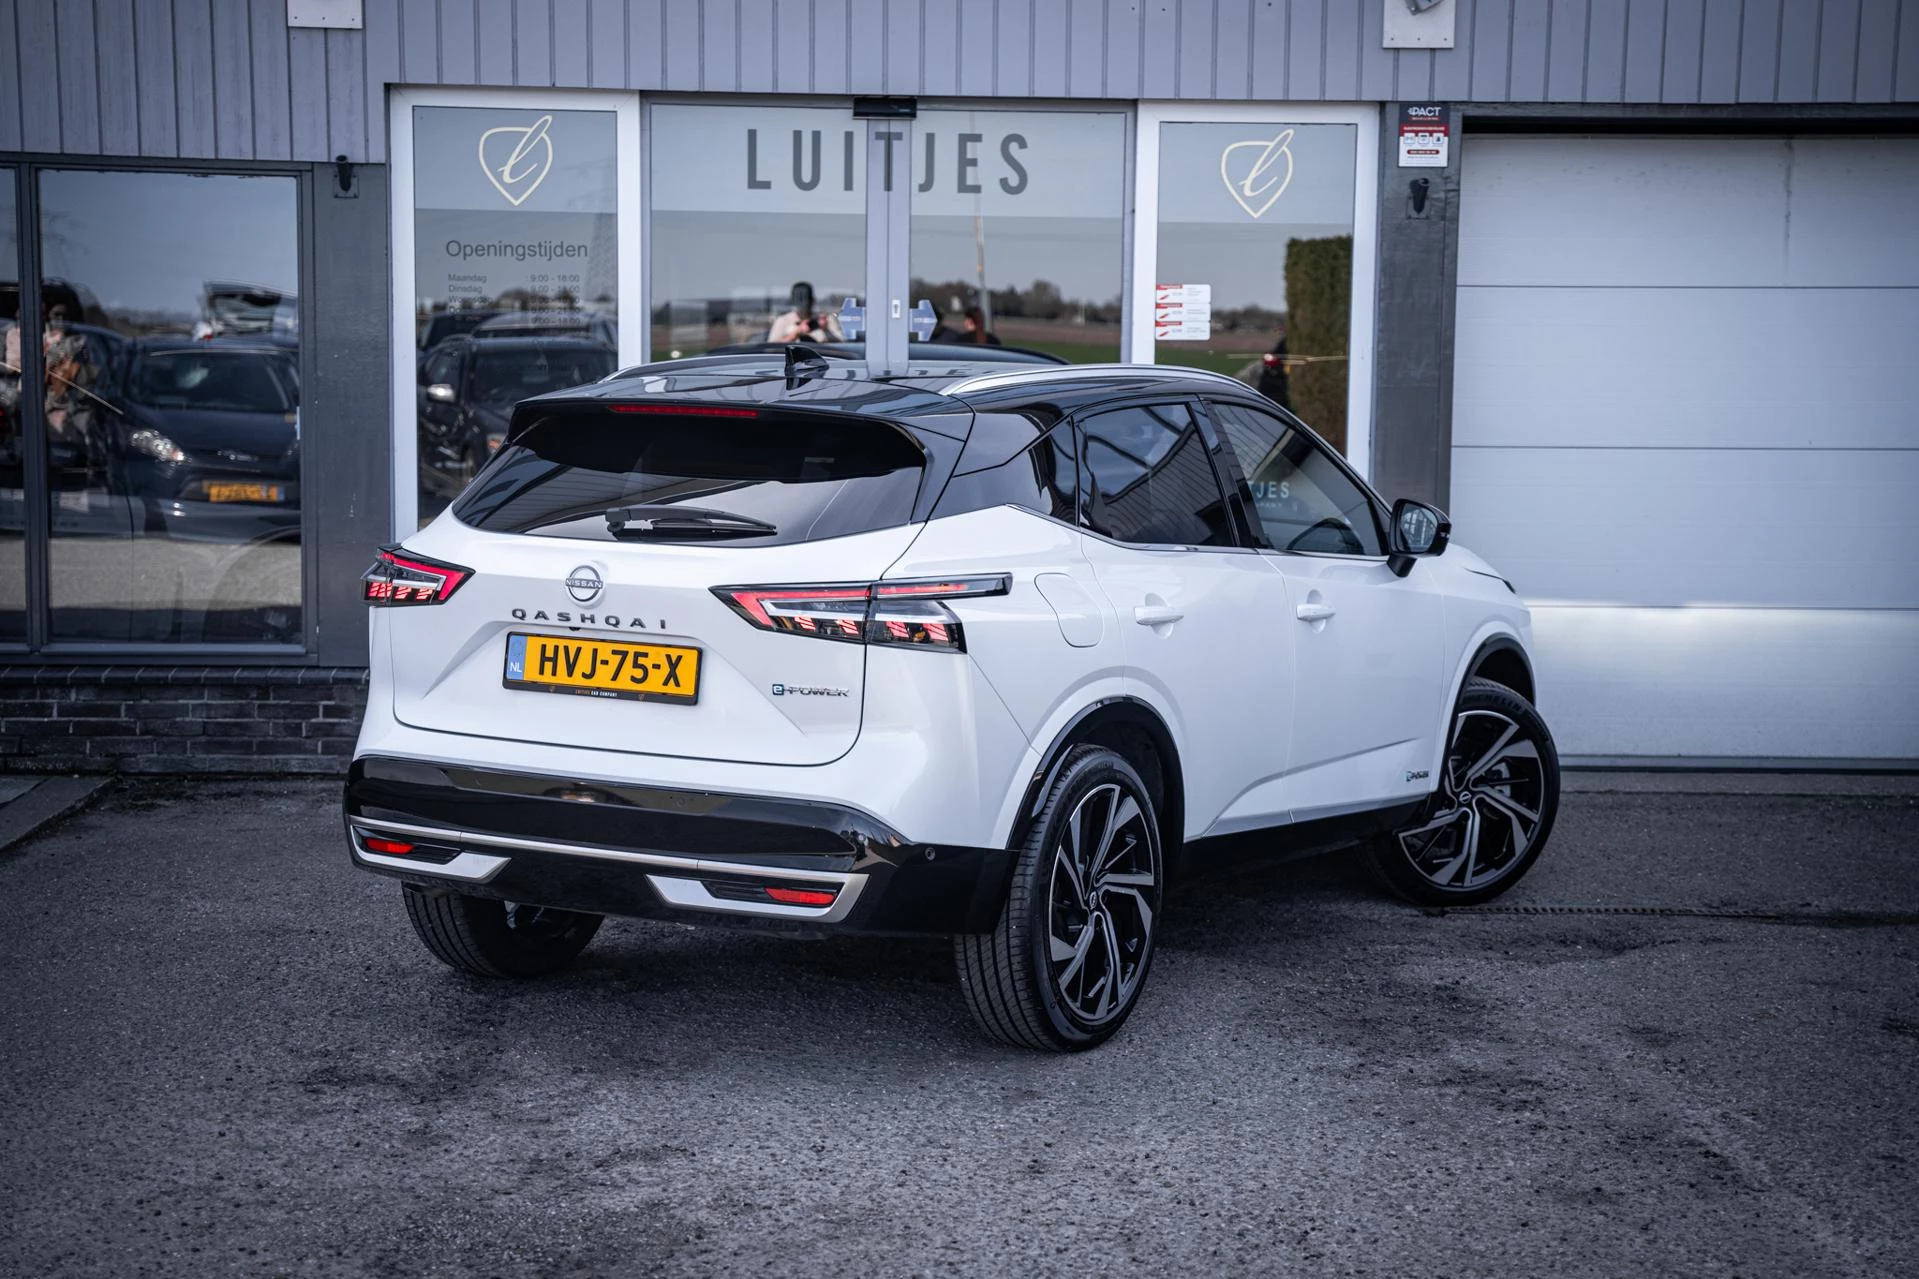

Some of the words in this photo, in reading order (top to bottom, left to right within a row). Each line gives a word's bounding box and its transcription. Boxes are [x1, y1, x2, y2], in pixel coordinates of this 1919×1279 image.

[747, 128, 1028, 195] LUITJES
[446, 240, 588, 261] Openingstijden
[448, 274, 487, 283] Maandag
[566, 579, 602, 588] NISSAN
[511, 608, 666, 629] QASHQAI
[510, 662, 523, 673] NL
[538, 644, 683, 688] HVJ-75-X
